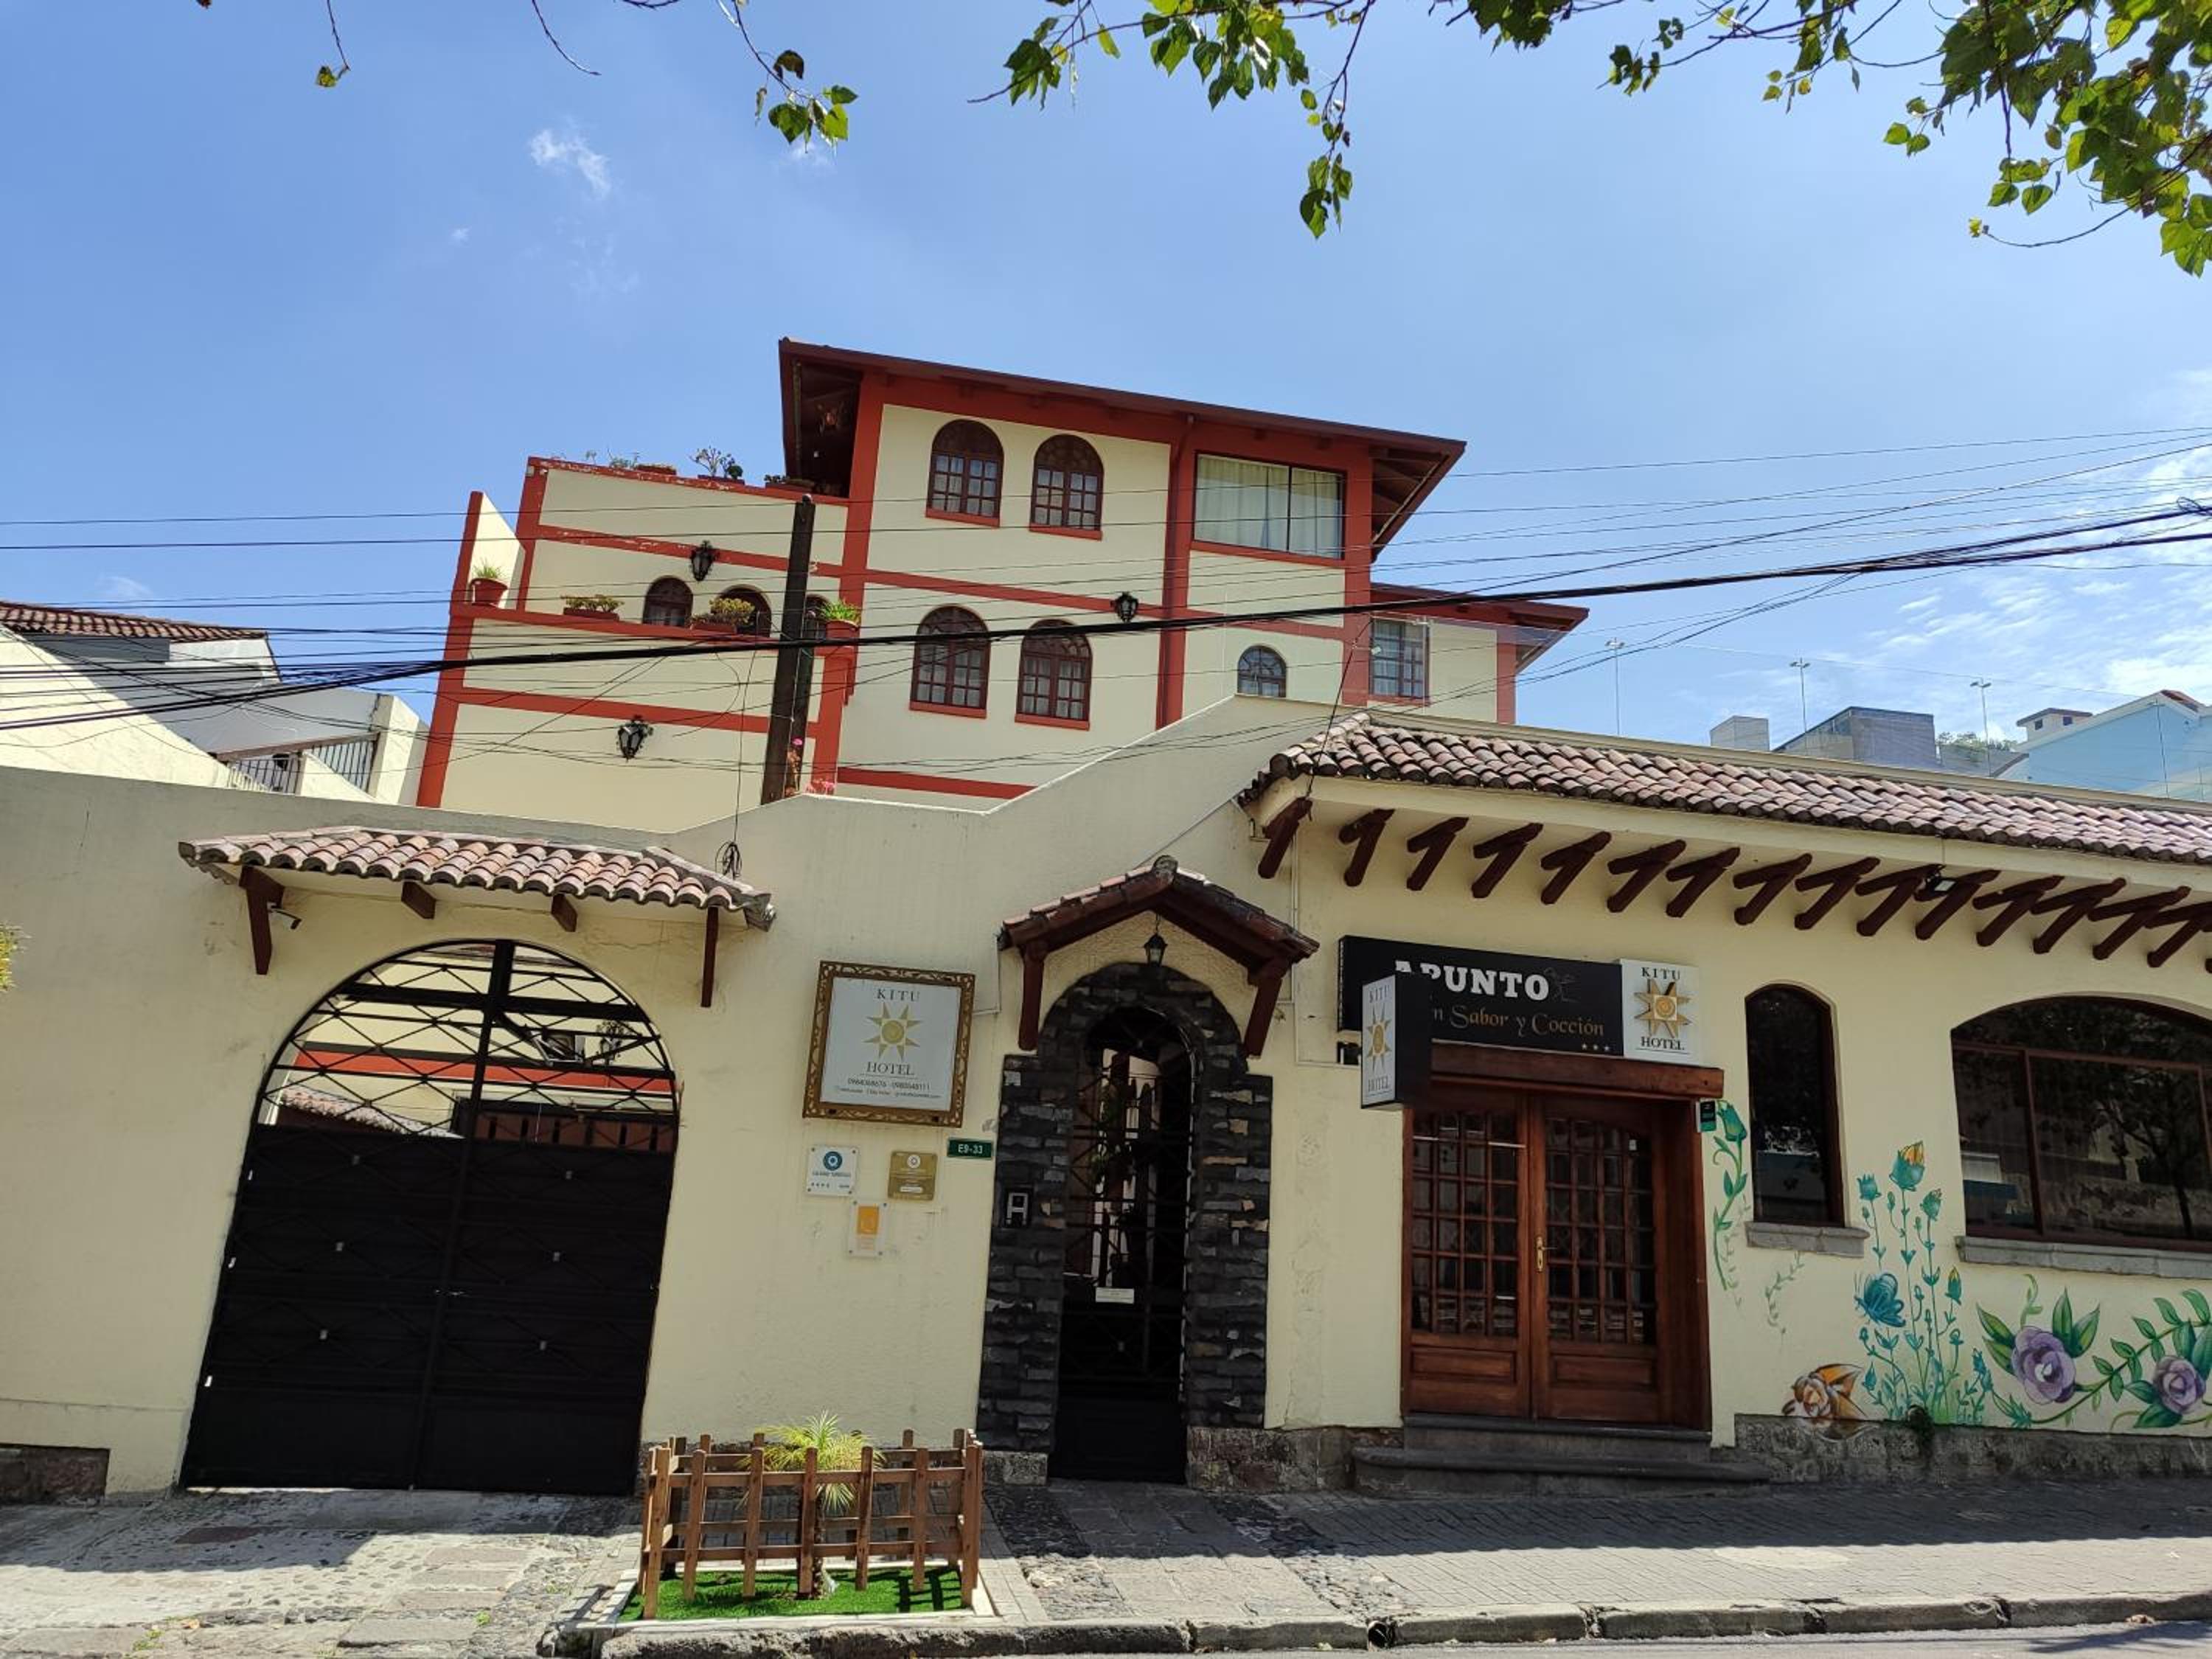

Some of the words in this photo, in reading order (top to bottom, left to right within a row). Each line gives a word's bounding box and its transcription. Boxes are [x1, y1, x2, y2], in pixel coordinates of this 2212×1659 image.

[1641, 967, 1680, 980] KITU
[877, 988, 920, 1002] KITU
[1450, 1004, 1509, 1029] Sabor
[1516, 1015, 1526, 1037] y
[1531, 1012, 1604, 1037] Cocción
[1641, 1037, 1685, 1051] HOTEL
[866, 1061, 915, 1076] HOTEL
[958, 1144, 984, 1155] E9-33
